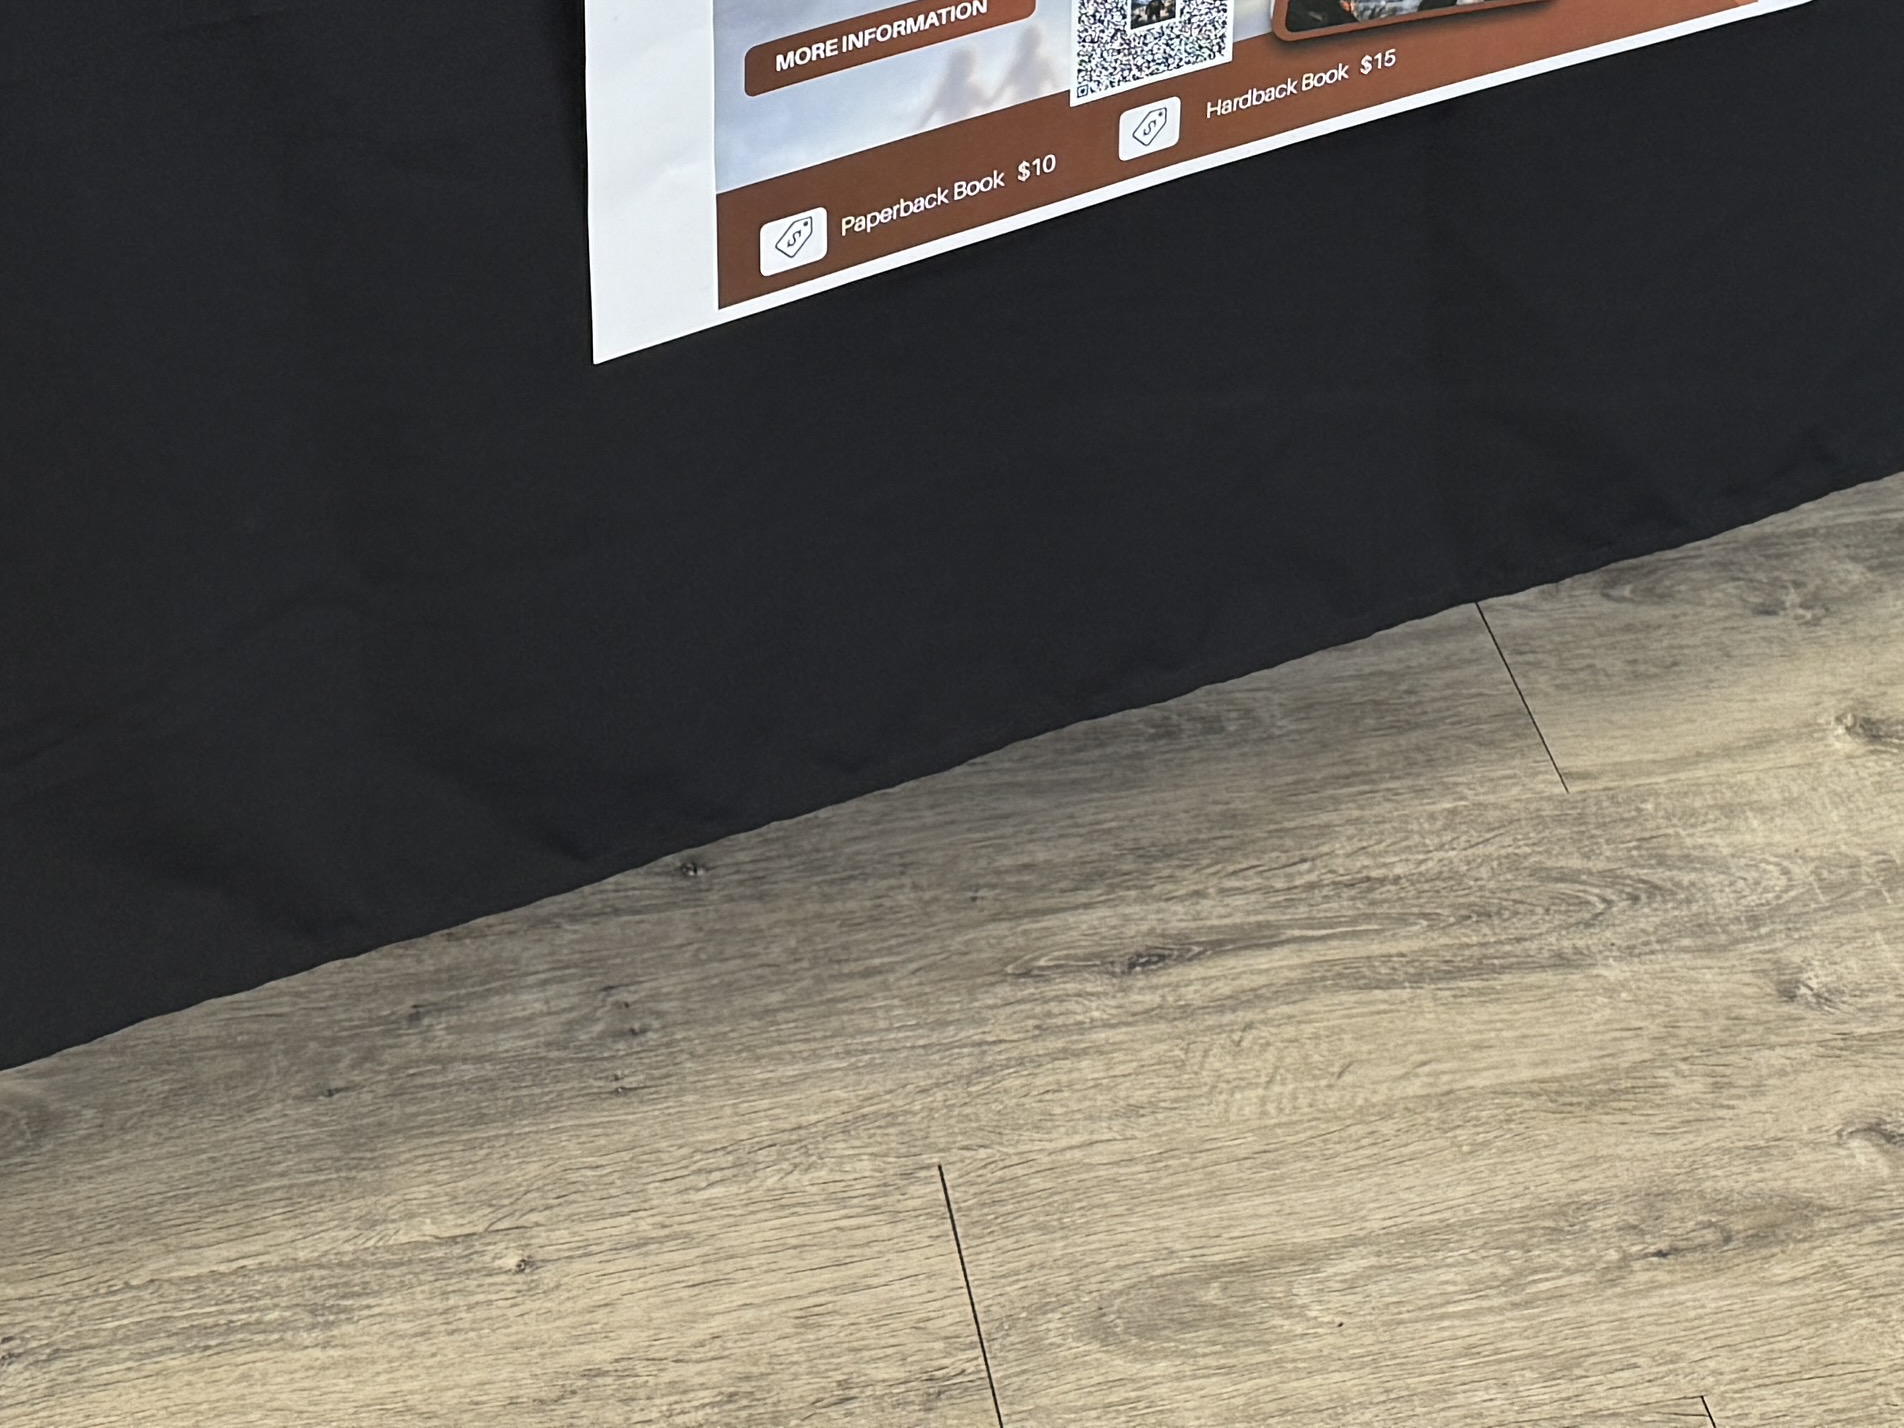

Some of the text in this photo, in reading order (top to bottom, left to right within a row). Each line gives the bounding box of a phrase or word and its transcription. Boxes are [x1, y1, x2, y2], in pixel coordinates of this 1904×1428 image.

[775, 37, 839, 73] MORE
[1205, 47, 1398, 120] Hardback Book $15
[840, 153, 1058, 237] Paperback Book $10
